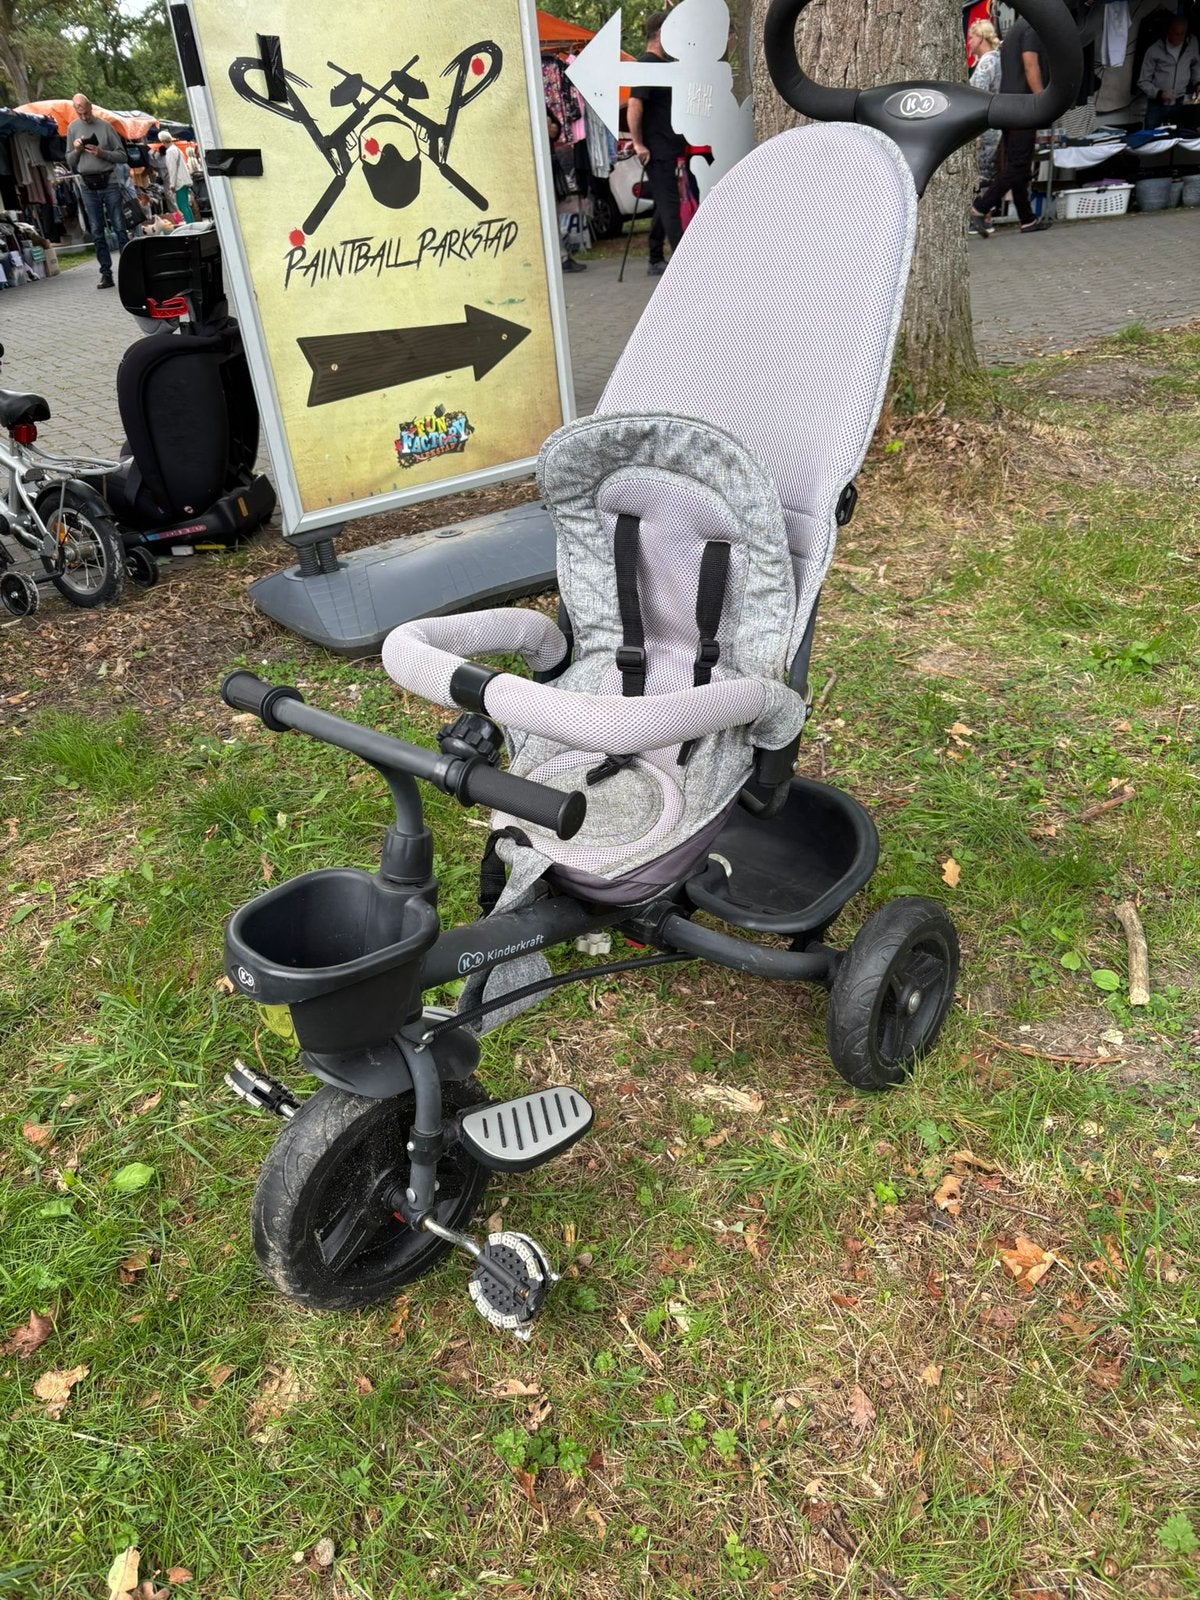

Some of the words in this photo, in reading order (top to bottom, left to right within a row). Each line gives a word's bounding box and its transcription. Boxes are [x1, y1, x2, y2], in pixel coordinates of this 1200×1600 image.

[283, 236, 418, 290] PAINTBALL
[417, 218, 518, 270] PARKSTAD
[401, 416, 468, 453] FACTORY
[414, 416, 447, 437] FUN
[486, 934, 544, 961] Kinderkraft
